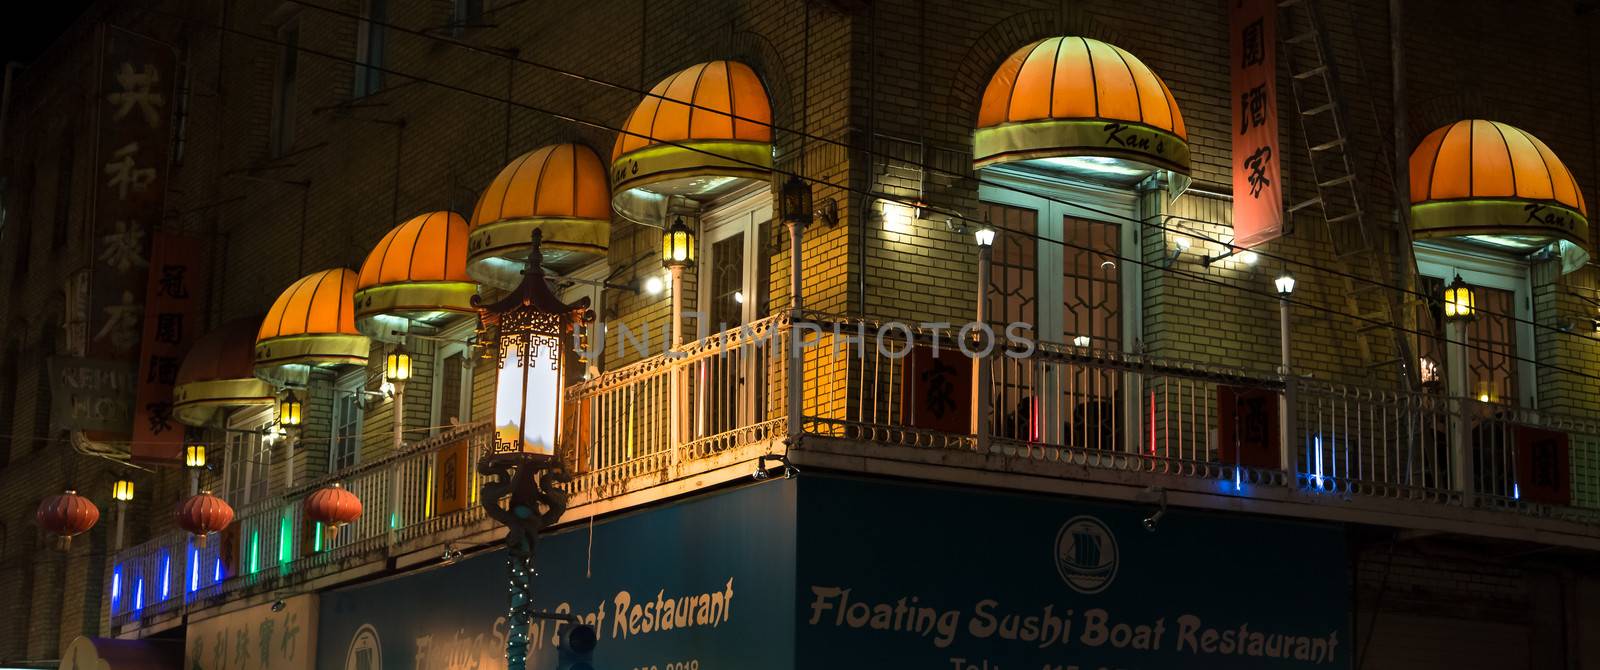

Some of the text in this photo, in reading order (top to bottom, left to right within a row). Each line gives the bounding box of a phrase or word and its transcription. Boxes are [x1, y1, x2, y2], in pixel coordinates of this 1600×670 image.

[1104, 121, 1165, 155] Kan's
[1525, 201, 1574, 231] Kan's
[611, 576, 735, 640] Restaurant
[808, 584, 1340, 664] Floating Sushi Boat Restaurant
